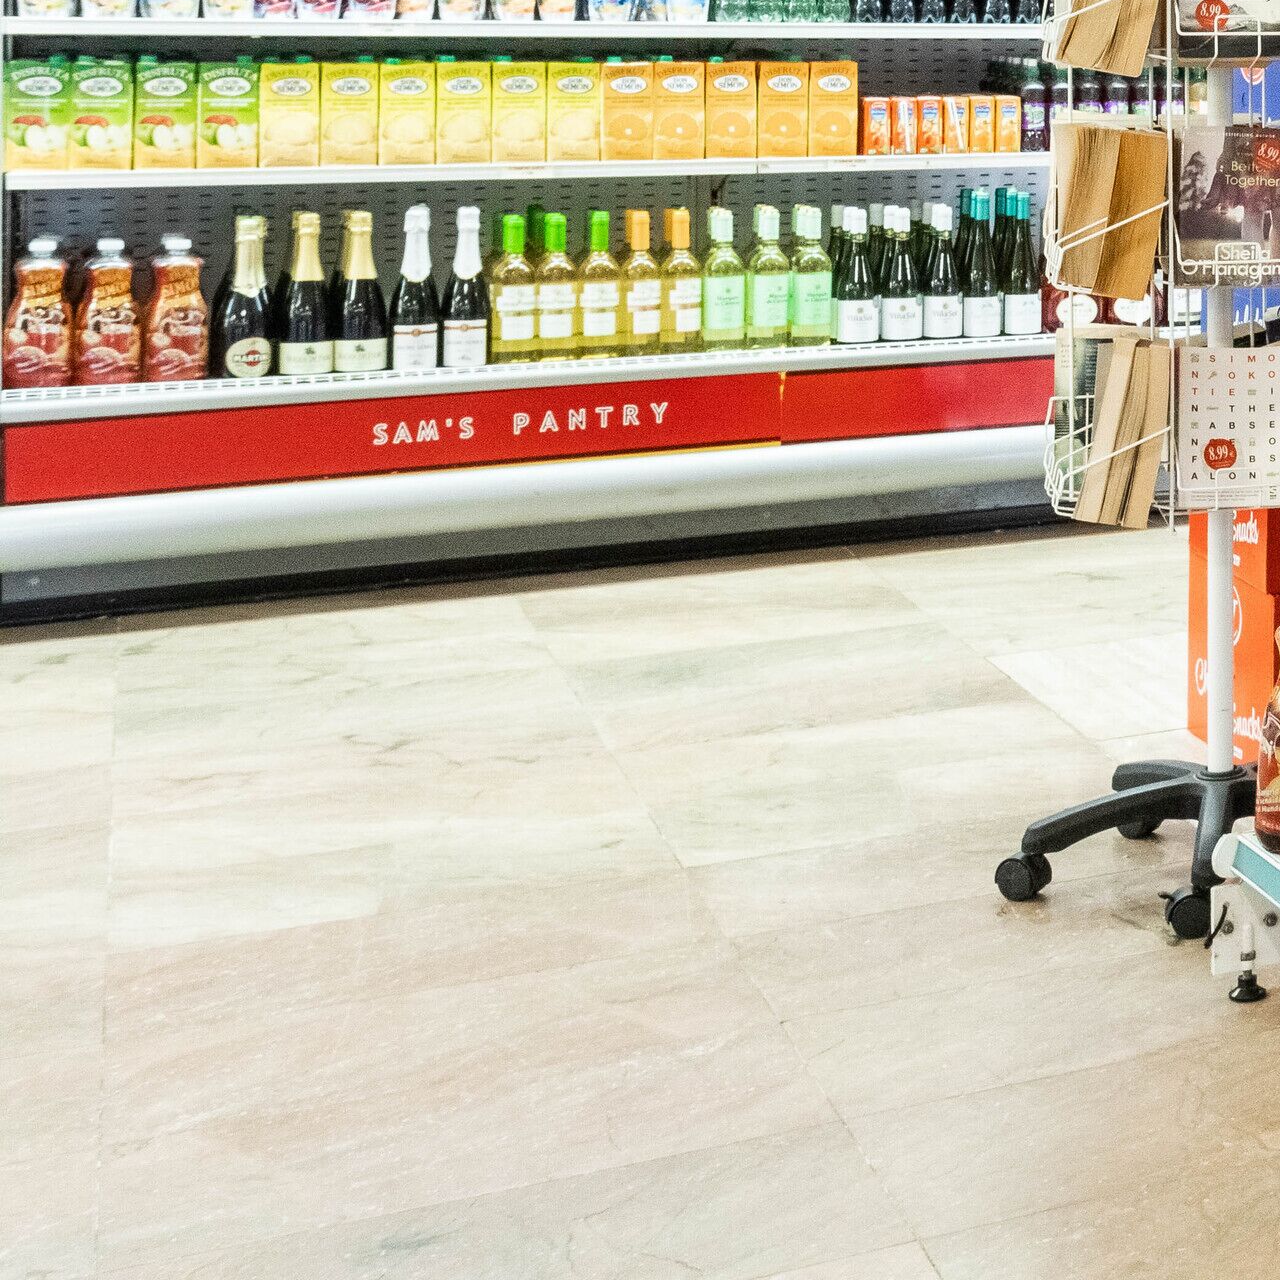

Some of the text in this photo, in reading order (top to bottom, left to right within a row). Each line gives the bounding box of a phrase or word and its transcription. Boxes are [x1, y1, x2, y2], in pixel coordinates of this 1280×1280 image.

[1224, 174, 1280, 189] Together
[373, 402, 668, 445] SAM'S PANTRY
